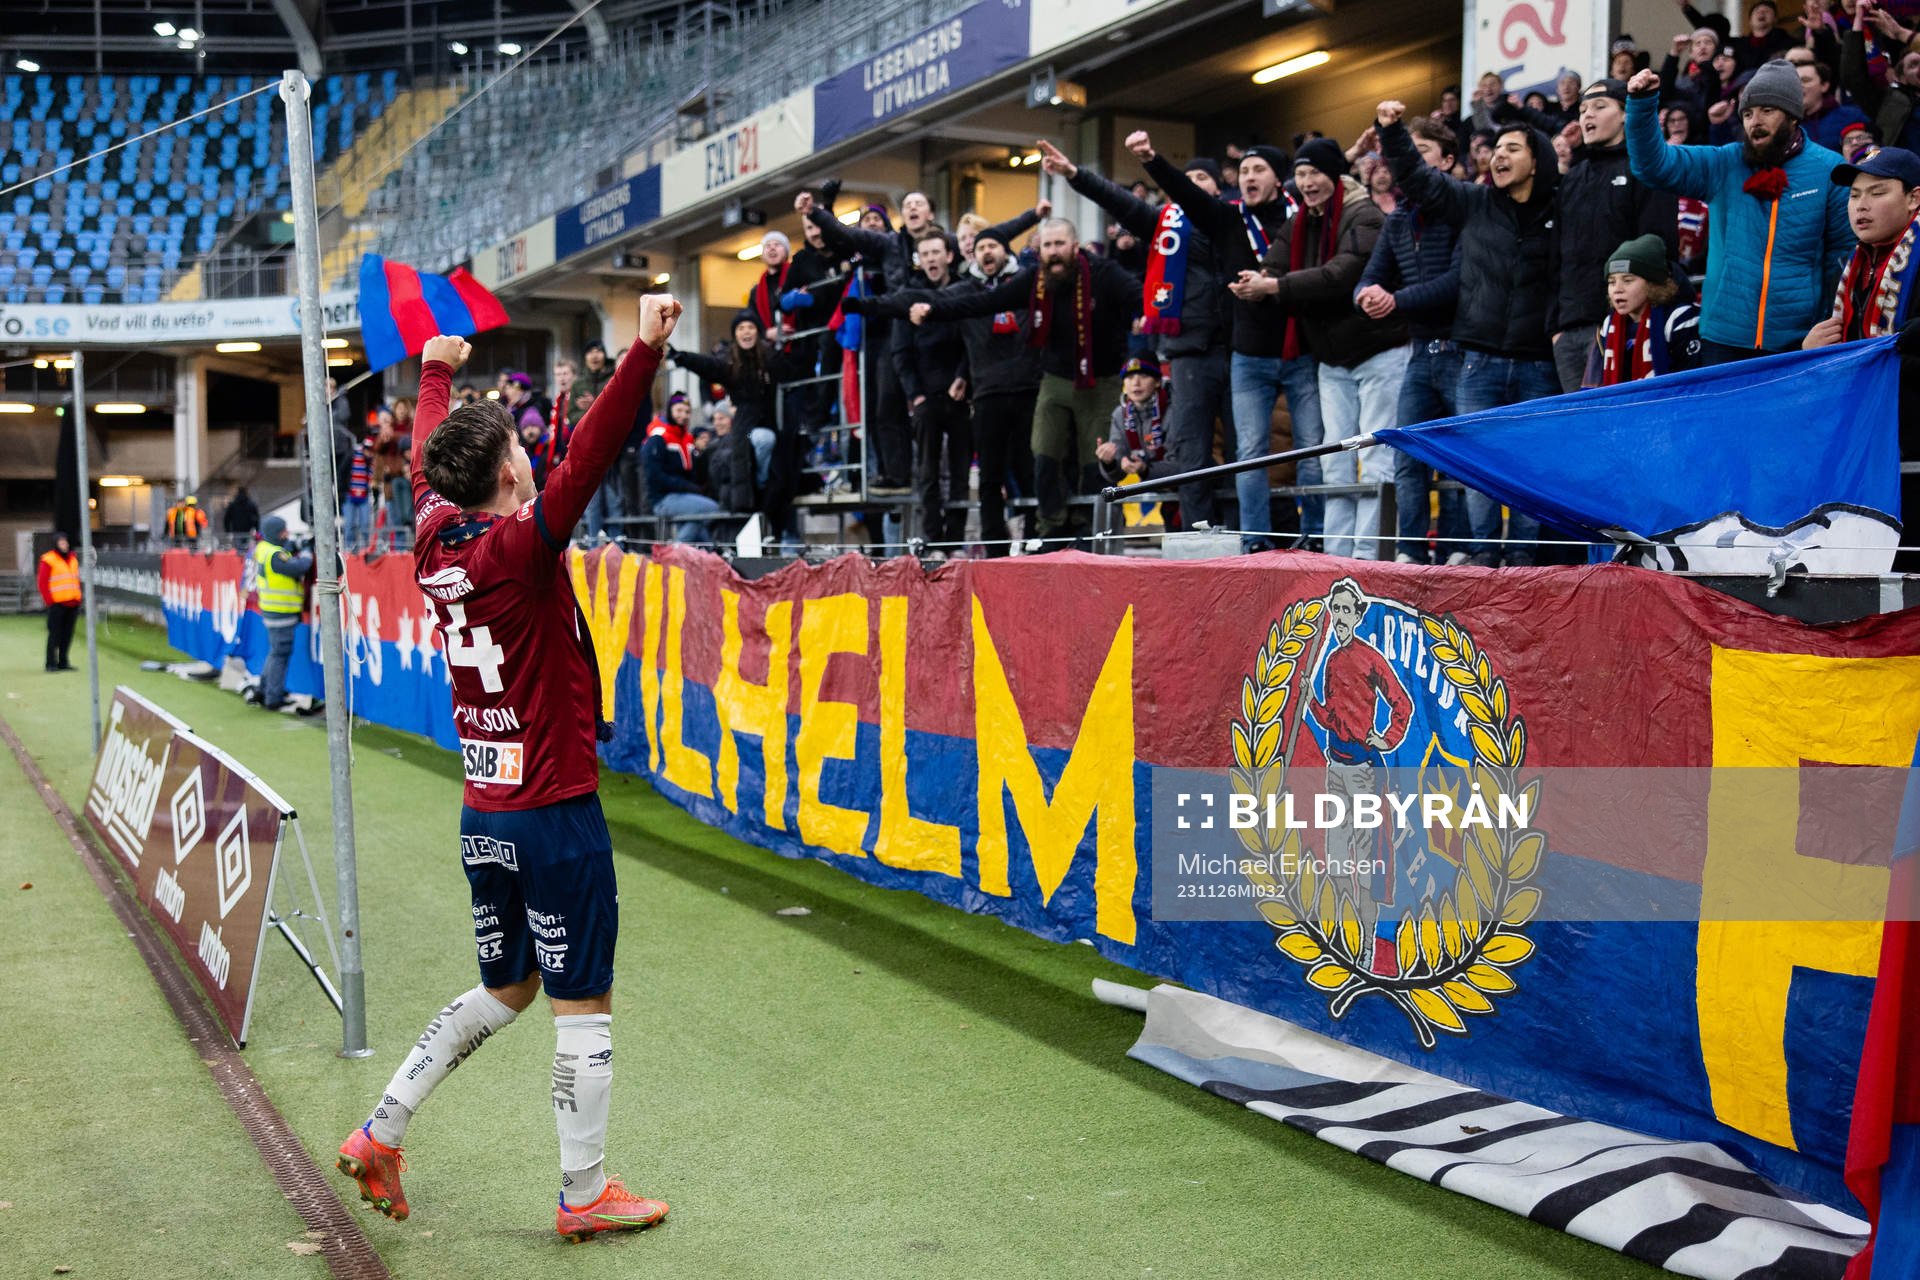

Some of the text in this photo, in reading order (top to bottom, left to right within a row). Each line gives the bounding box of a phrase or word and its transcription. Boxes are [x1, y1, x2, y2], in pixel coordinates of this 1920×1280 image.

[864, 18, 962, 92] LEGENDENS
[873, 60, 950, 118] UTVALDA
[569, 545, 1138, 946] WILHELM
[155, 866, 185, 924] umbro
[199, 920, 230, 991] umbro
[406, 1055, 433, 1081] umbro
[551, 1052, 580, 1113] MIKE
